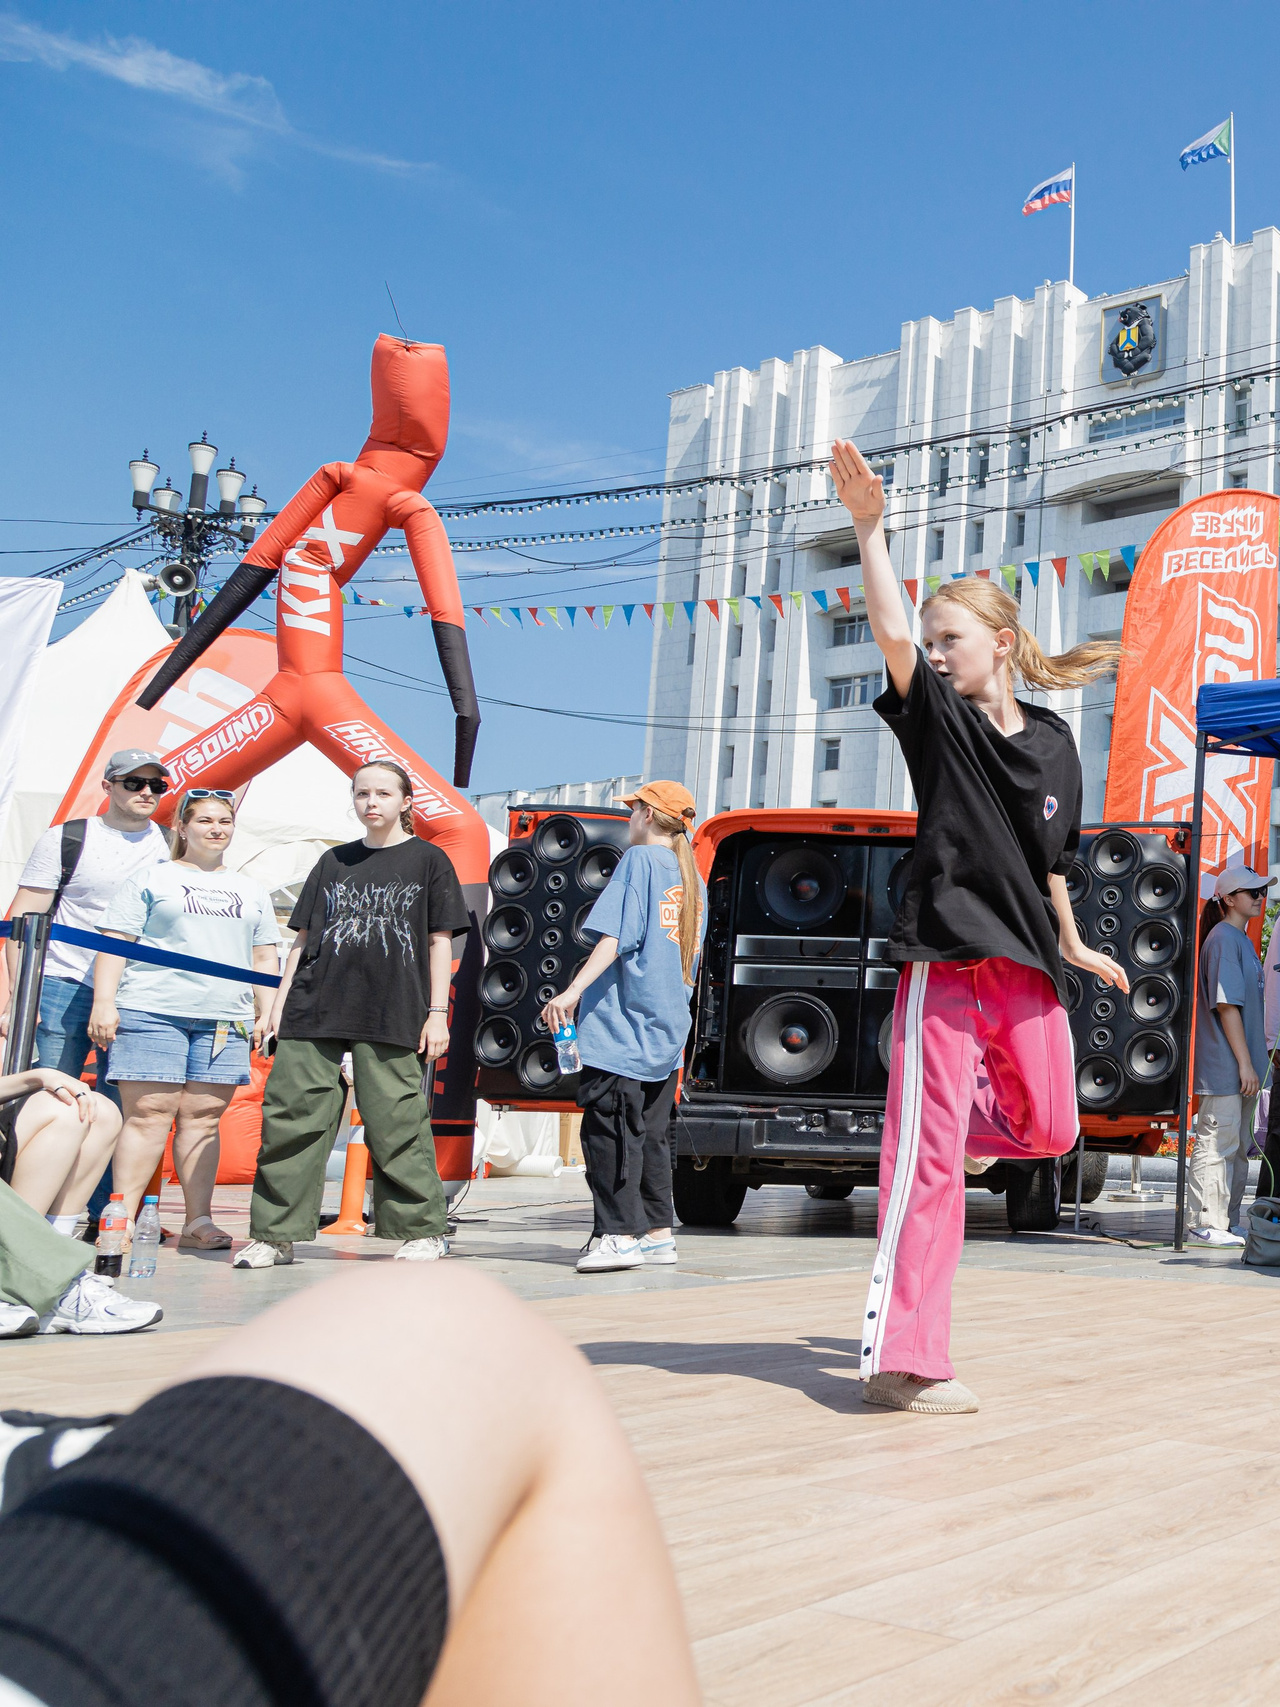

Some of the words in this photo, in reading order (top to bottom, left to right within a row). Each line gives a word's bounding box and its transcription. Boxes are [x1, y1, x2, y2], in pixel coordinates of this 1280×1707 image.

[1194, 511, 1261, 536] ЗВУЧИ
[1165, 544, 1275, 578] ВЕСЕЛИСЬ
[184, 704, 270, 772] SOUND
[334, 723, 404, 770] HAV
[662, 907, 681, 921] OL
